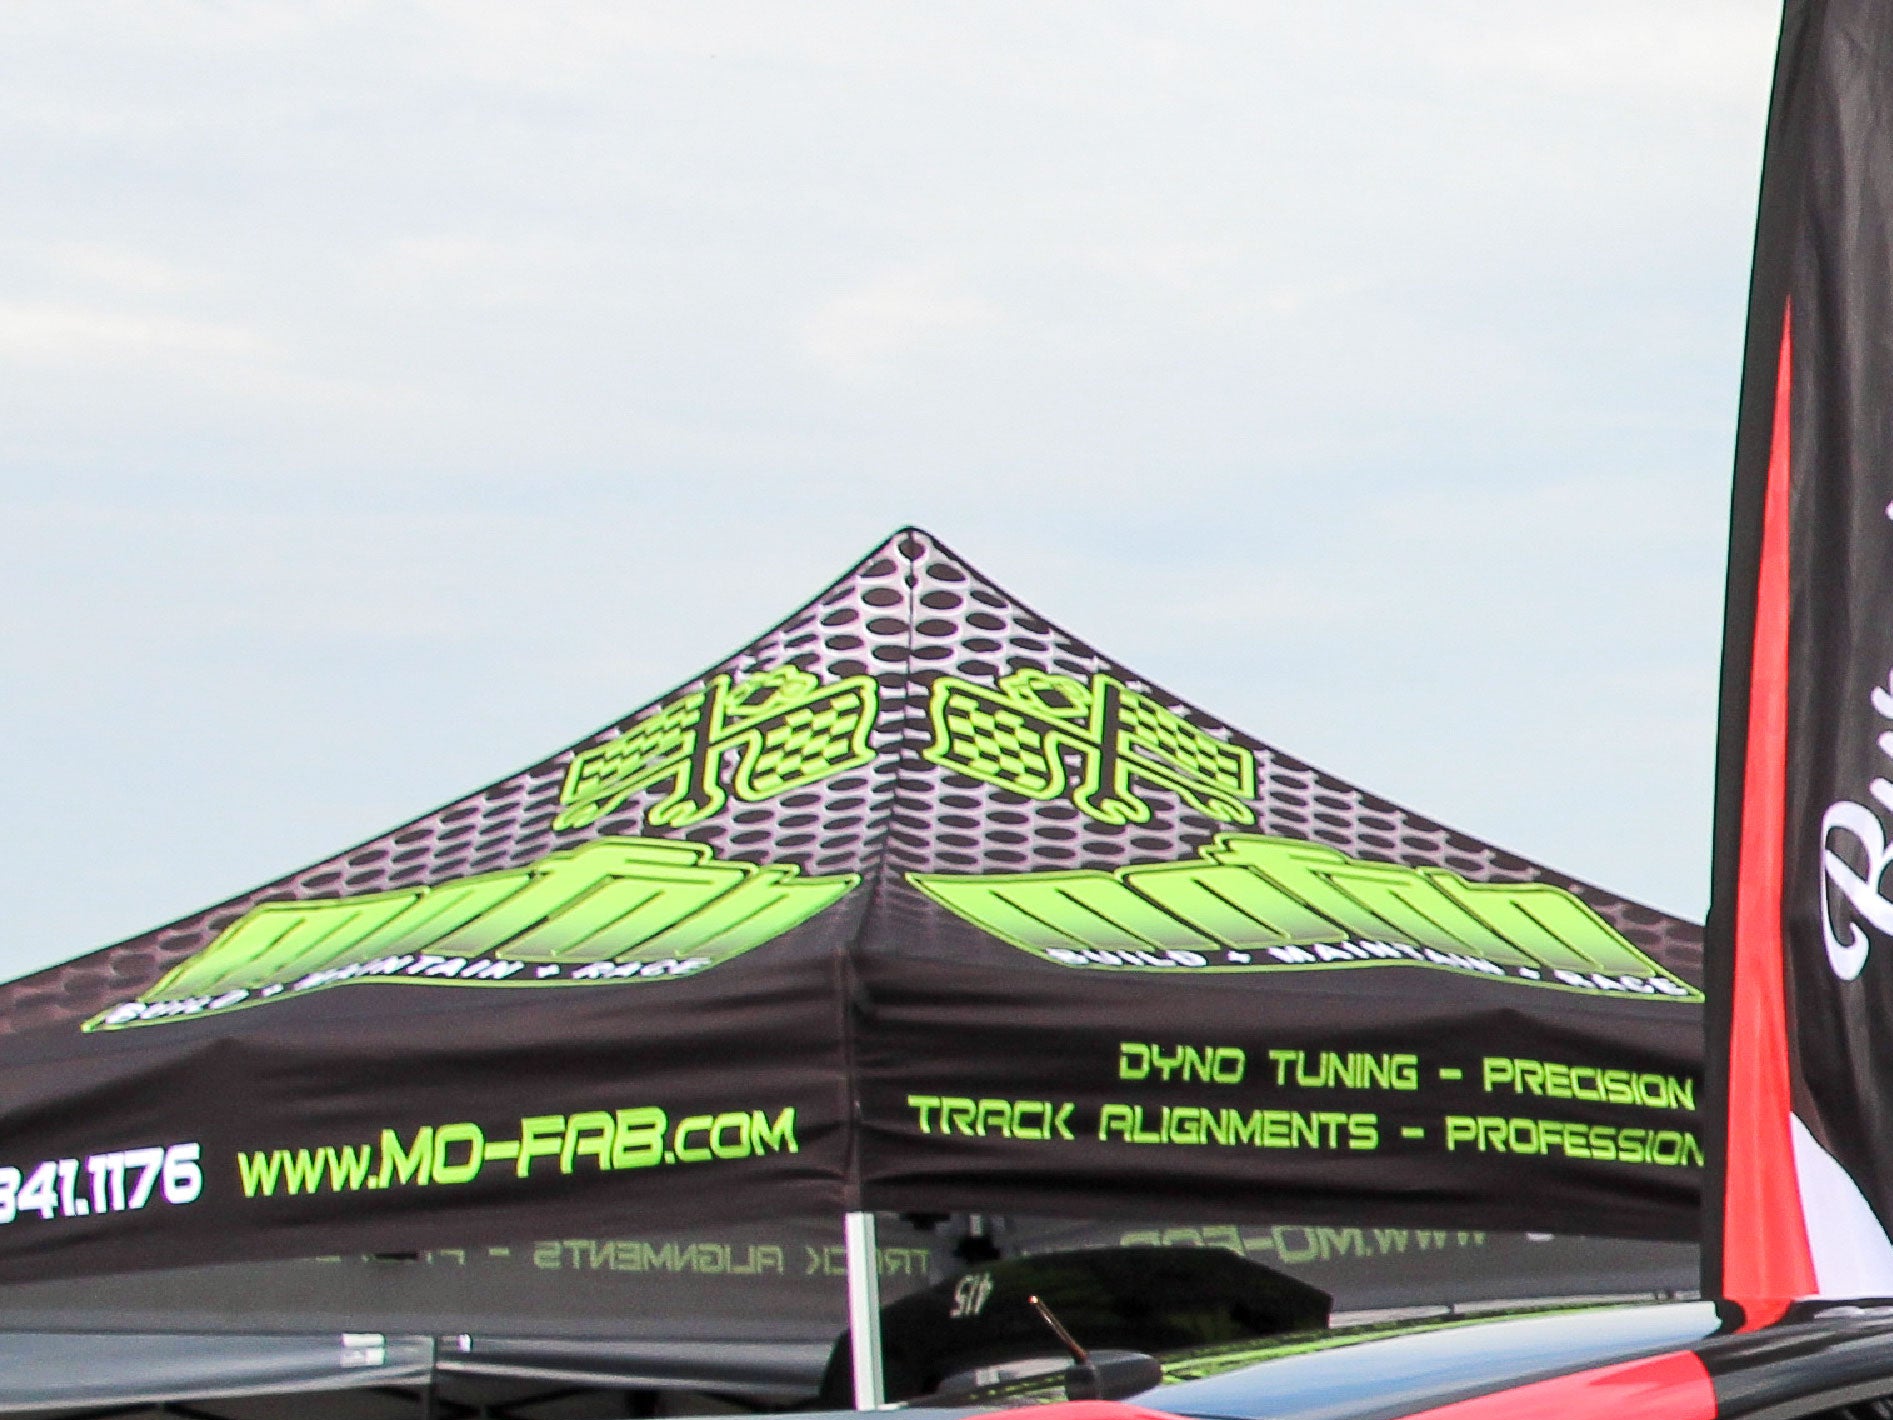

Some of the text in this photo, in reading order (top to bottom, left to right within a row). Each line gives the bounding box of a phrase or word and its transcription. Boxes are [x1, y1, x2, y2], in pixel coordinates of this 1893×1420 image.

[1119, 1042, 1246, 1084] DYNO
[1268, 1050, 1419, 1091] TUNING
[1482, 1056, 1697, 1112] PRECISION
[908, 1095, 1075, 1141] TRACK
[1099, 1103, 1379, 1151] ALIGNMENTS
